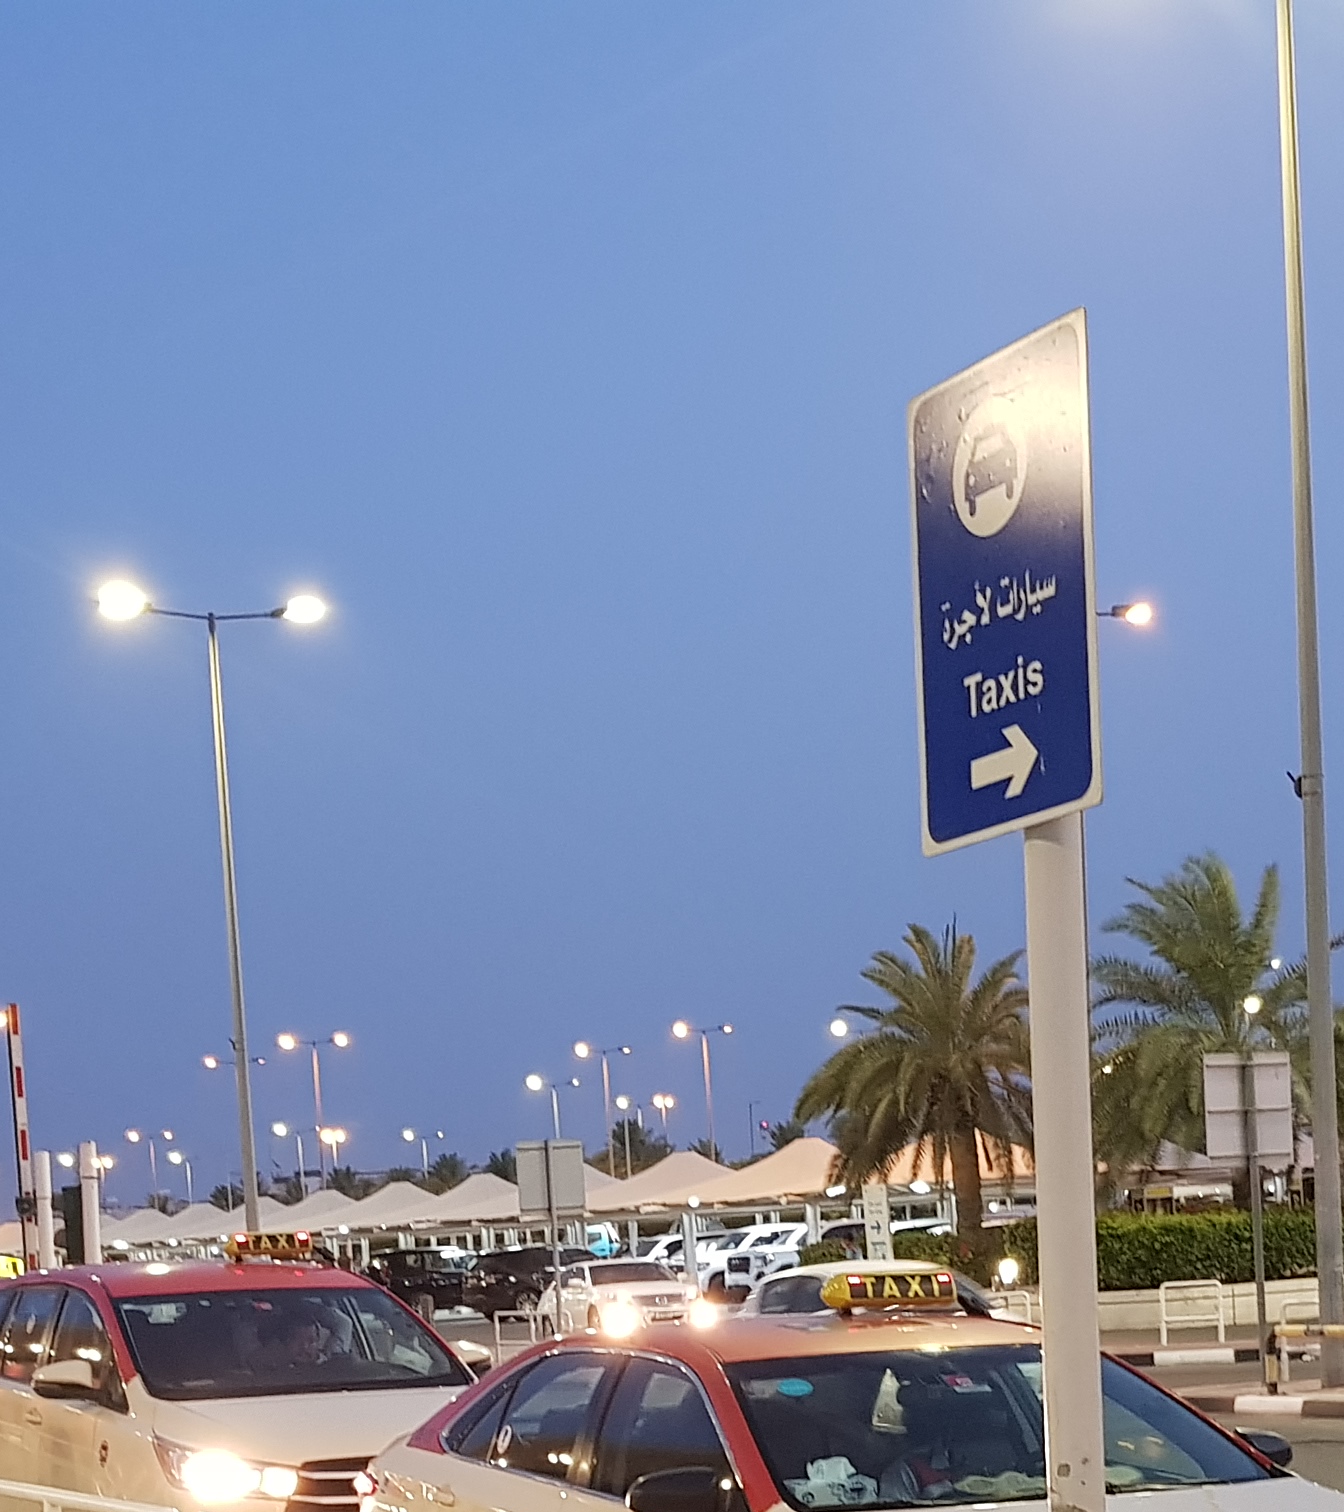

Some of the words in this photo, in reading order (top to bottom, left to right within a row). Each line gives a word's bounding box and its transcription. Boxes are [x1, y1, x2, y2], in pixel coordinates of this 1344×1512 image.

[996, 568, 1056, 622] سيارات
[963, 654, 1044, 719] Taxis
[863, 1275, 940, 1299] TAXI
